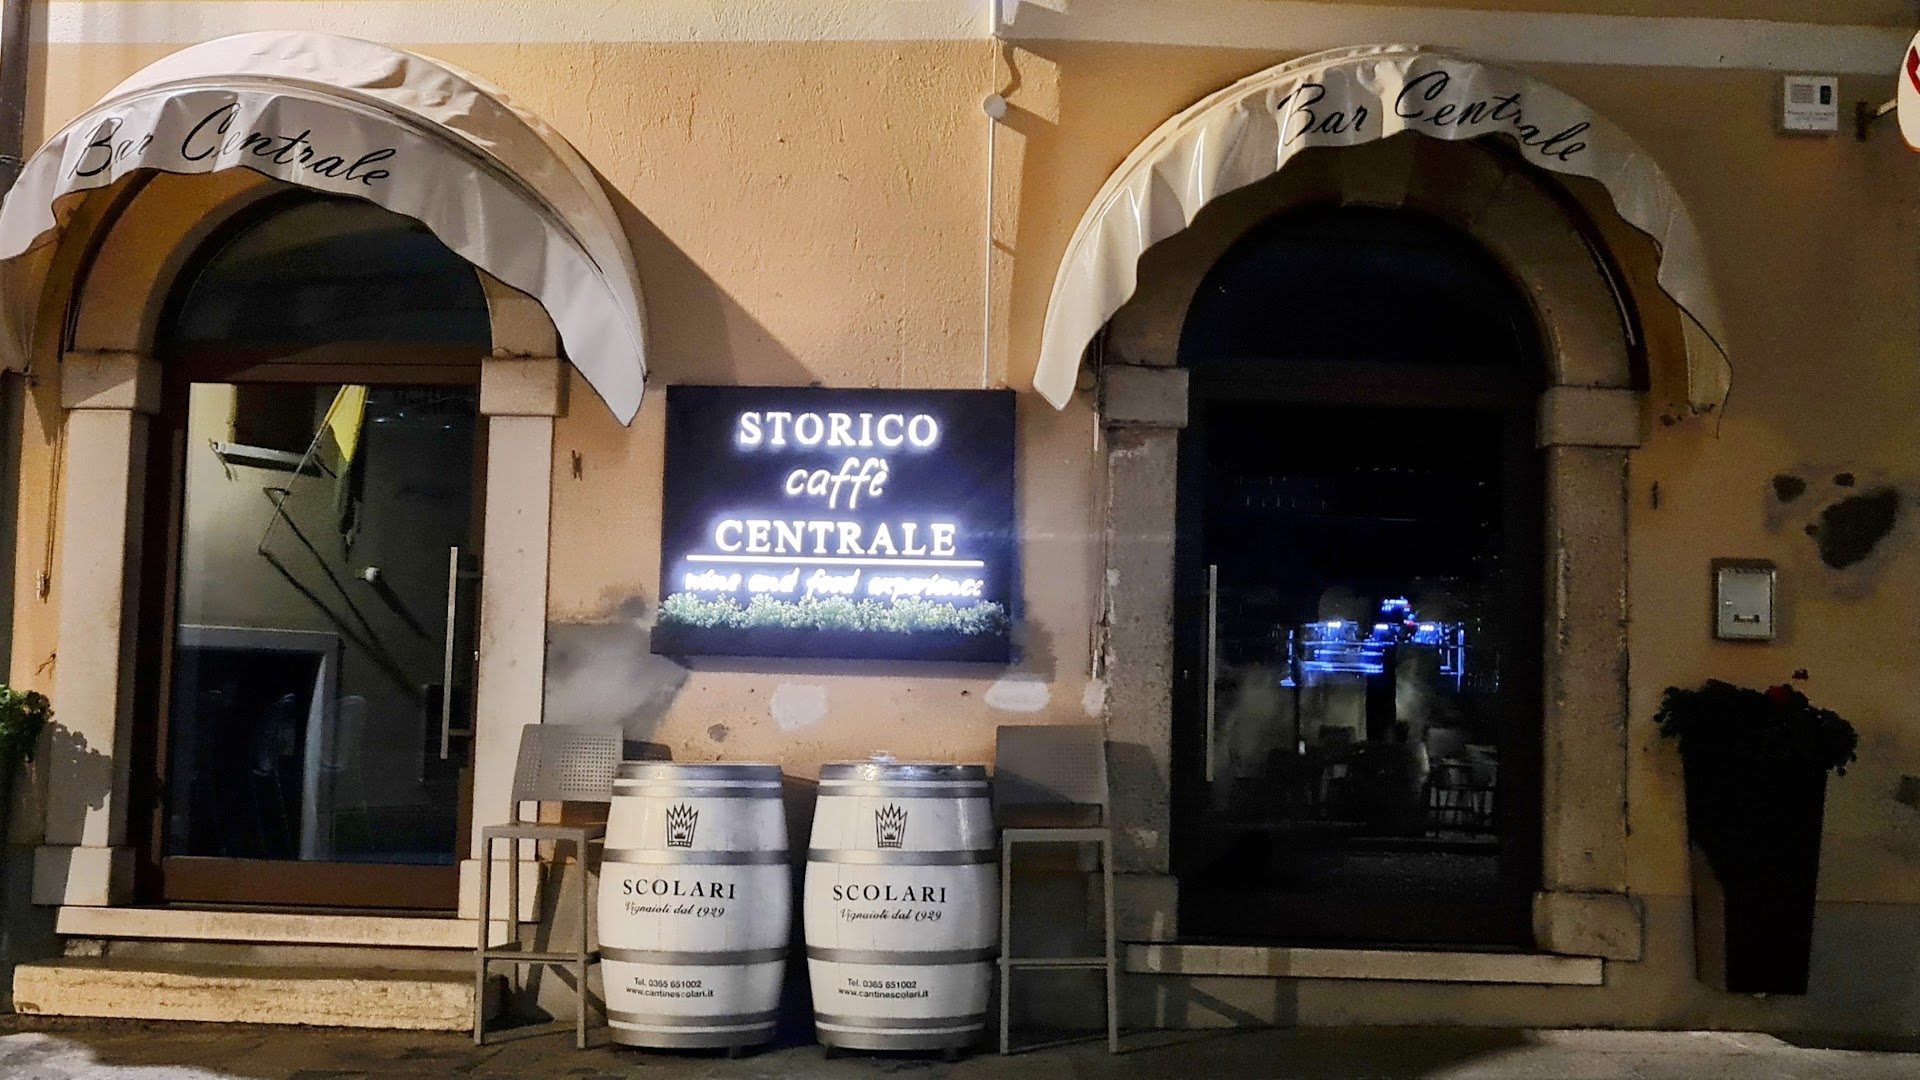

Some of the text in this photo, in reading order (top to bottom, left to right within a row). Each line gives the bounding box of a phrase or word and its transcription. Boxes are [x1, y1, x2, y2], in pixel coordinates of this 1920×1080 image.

[1277, 70, 1590, 162] Bar Centrale
[67, 102, 396, 186] Bar Centrale
[739, 411, 938, 447] STORICO
[785, 456, 890, 509] caffè
[715, 519, 957, 556] CENTRALE
[684, 568, 742, 592] wine
[747, 567, 801, 593] and
[804, 567, 862, 600] food
[622, 878, 737, 900] SCOLARI
[832, 884, 947, 904] SCOLARI
[624, 901, 726, 918] Vignaioli dal 1929
[839, 908, 943, 922] Vignaioli dal 1929
[626, 986, 715, 998] www.cantinescolari.it
[634, 977, 703, 988] Tel. 0365 651002
[838, 987, 930, 999] www.cantinescolari.it
[847, 978, 918, 989] Tel. 0365 651002
